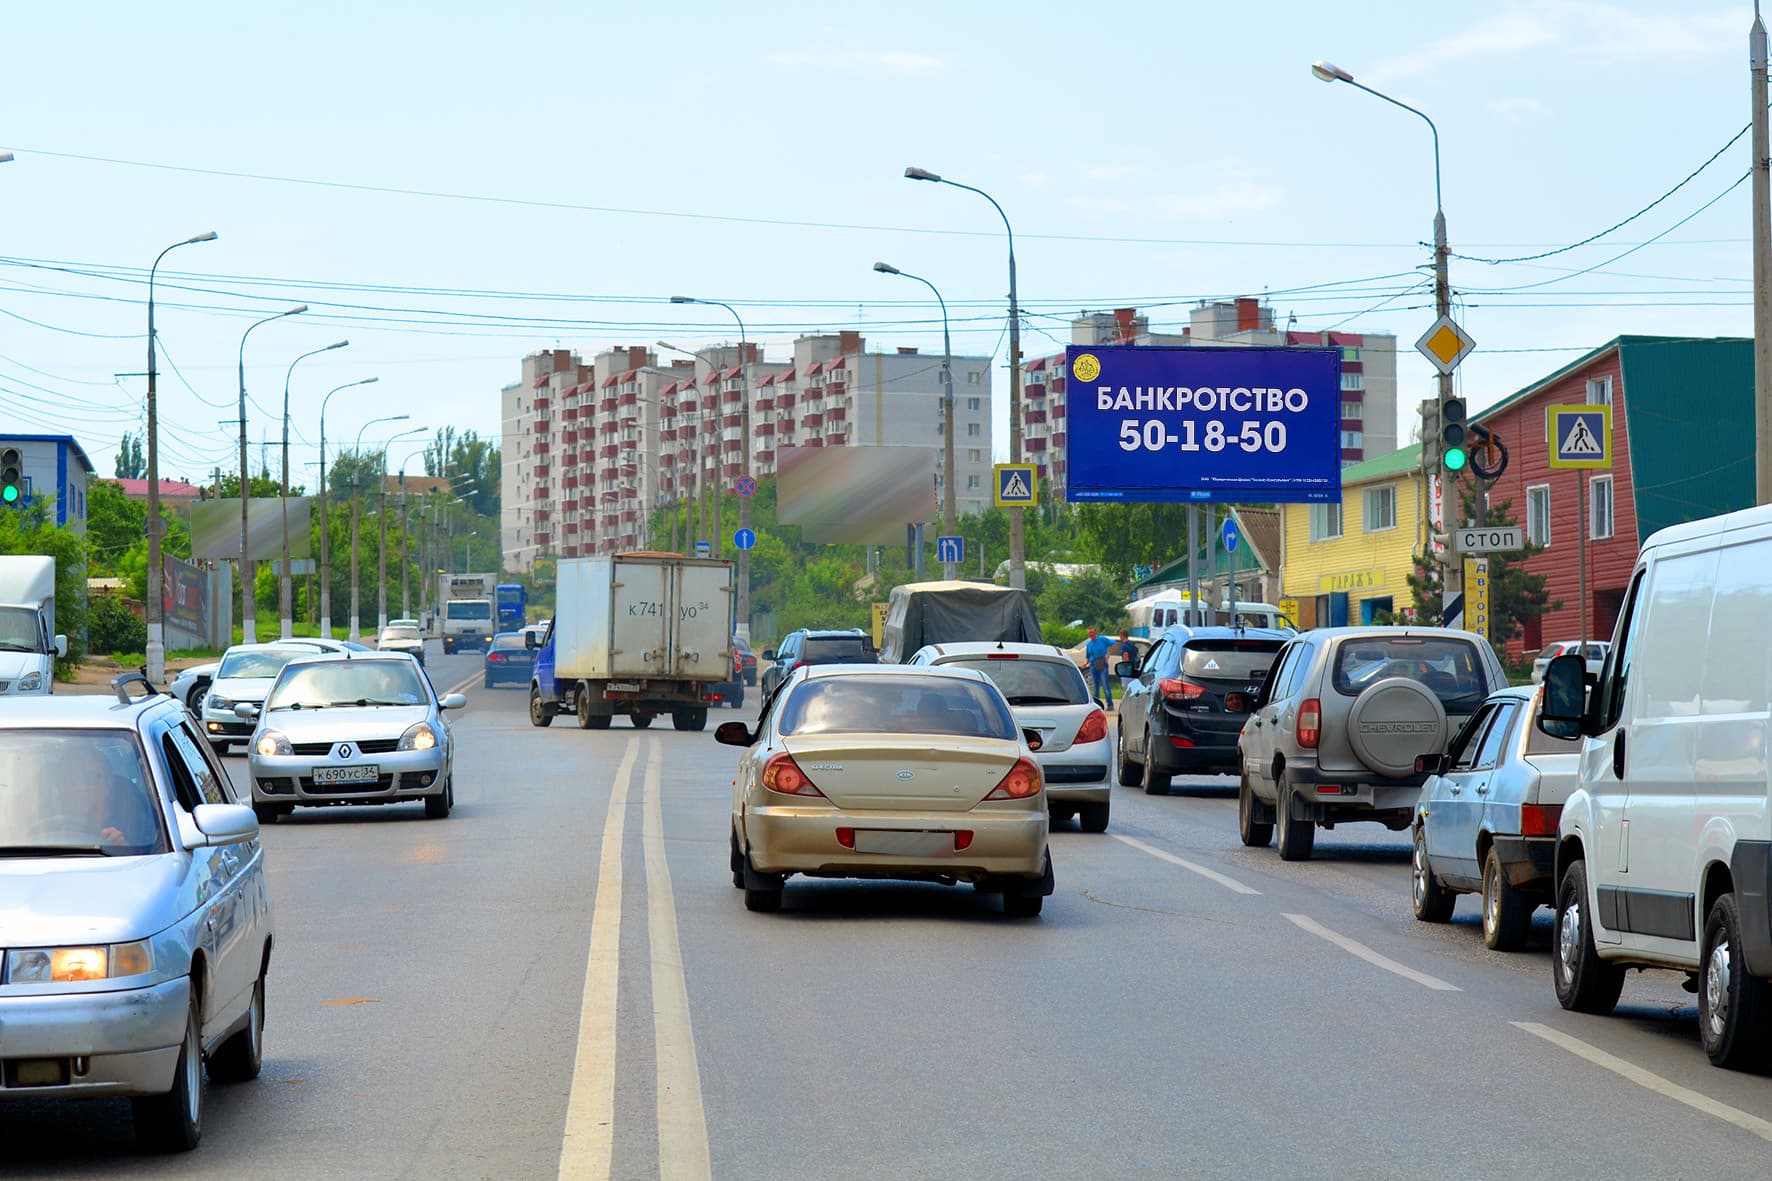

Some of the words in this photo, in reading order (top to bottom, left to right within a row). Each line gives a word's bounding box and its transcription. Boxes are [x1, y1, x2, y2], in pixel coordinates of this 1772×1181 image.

[1097, 387, 1309, 412] БАНКРОТСТВО
[1119, 418, 1287, 453] 50-18-50
[1465, 533, 1514, 547] СТОП
[1475, 563, 1487, 638] Авторе
[1360, 722, 1438, 733] CHEVROLET
